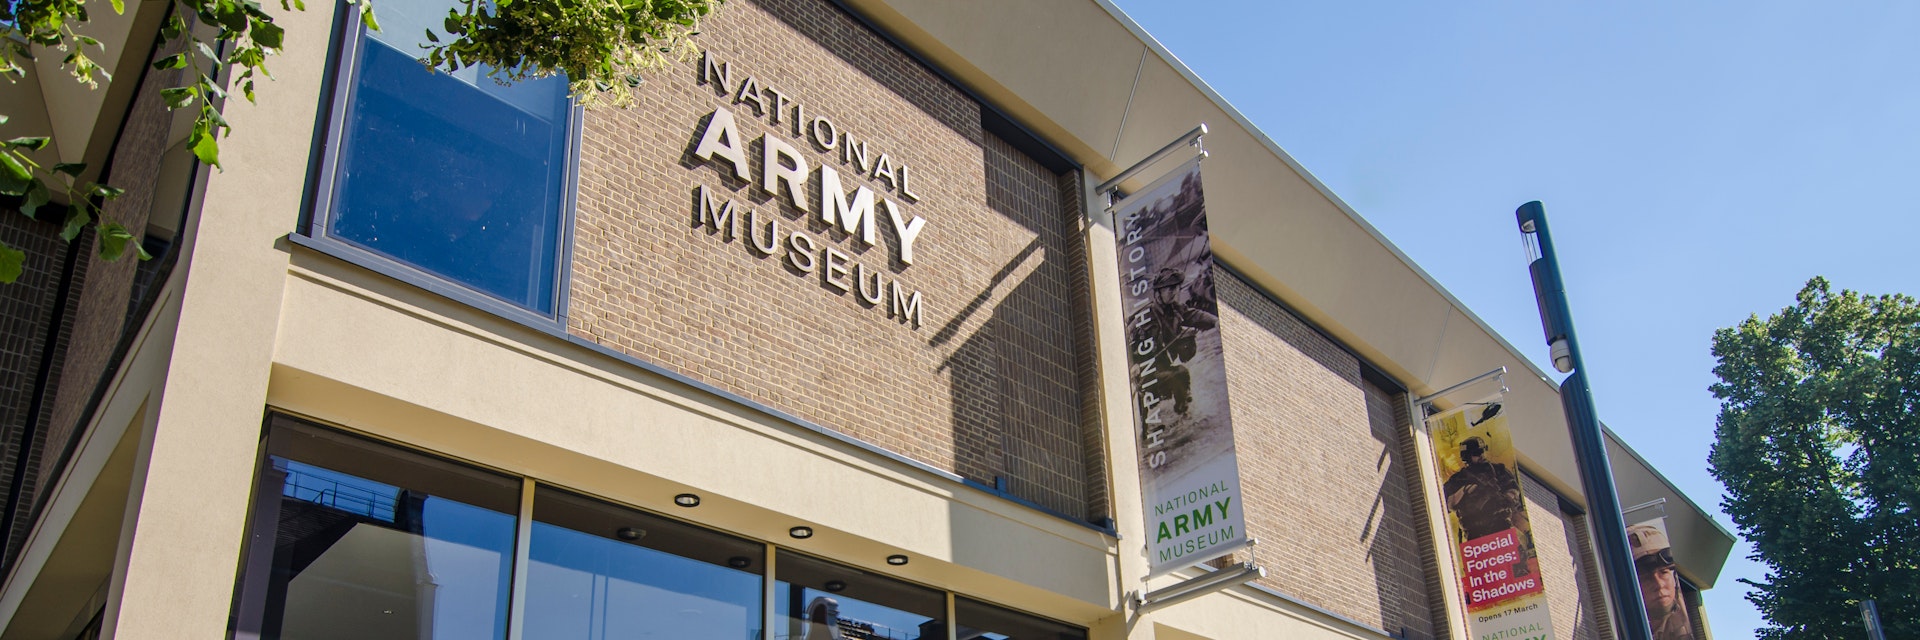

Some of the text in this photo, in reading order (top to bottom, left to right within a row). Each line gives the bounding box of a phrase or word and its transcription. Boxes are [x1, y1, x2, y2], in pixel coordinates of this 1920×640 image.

[704, 50, 919, 201] NATIONAL
[695, 106, 926, 265] ARMY
[700, 184, 922, 327] MUSEUM
[1126, 214, 1166, 469] SHAPING HISTORY
[1155, 480, 1229, 516] NATIONAL
[1156, 496, 1231, 544] ARMY
[1160, 525, 1234, 563] MUSEUM
[1463, 533, 1514, 559] Special
[1466, 551, 1517, 573] Forces:
[1469, 569, 1507, 588] In the
[1472, 578, 1535, 603] Shadows
[1478, 603, 1538, 623] Opens 17 March
[1482, 622, 1544, 640] NATIONAL
